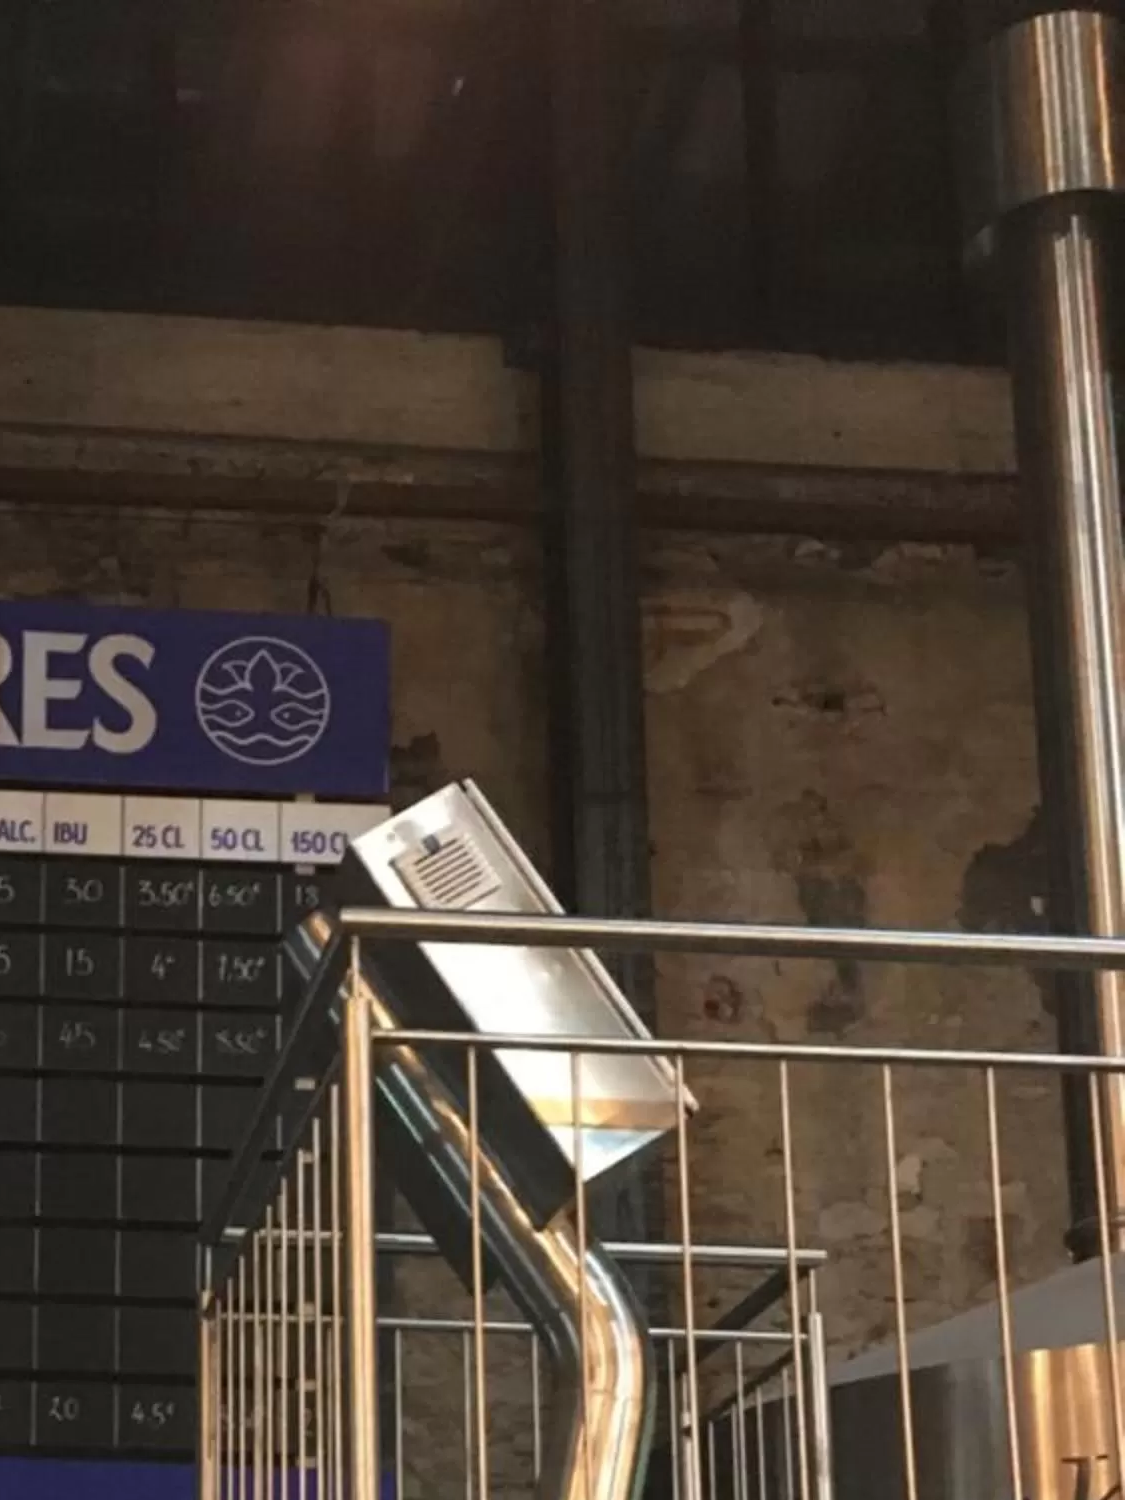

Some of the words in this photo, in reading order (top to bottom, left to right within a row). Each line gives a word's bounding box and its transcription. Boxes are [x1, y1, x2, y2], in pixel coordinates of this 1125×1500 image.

[52, 819, 89, 845] IBU
[132, 824, 160, 850] 25
[162, 826, 187, 850] CL
[210, 827, 237, 851] 50
[238, 828, 267, 852] CL
[289, 829, 327, 854] 150
[64, 877, 105, 904] 30
[64, 947, 97, 979] 15
